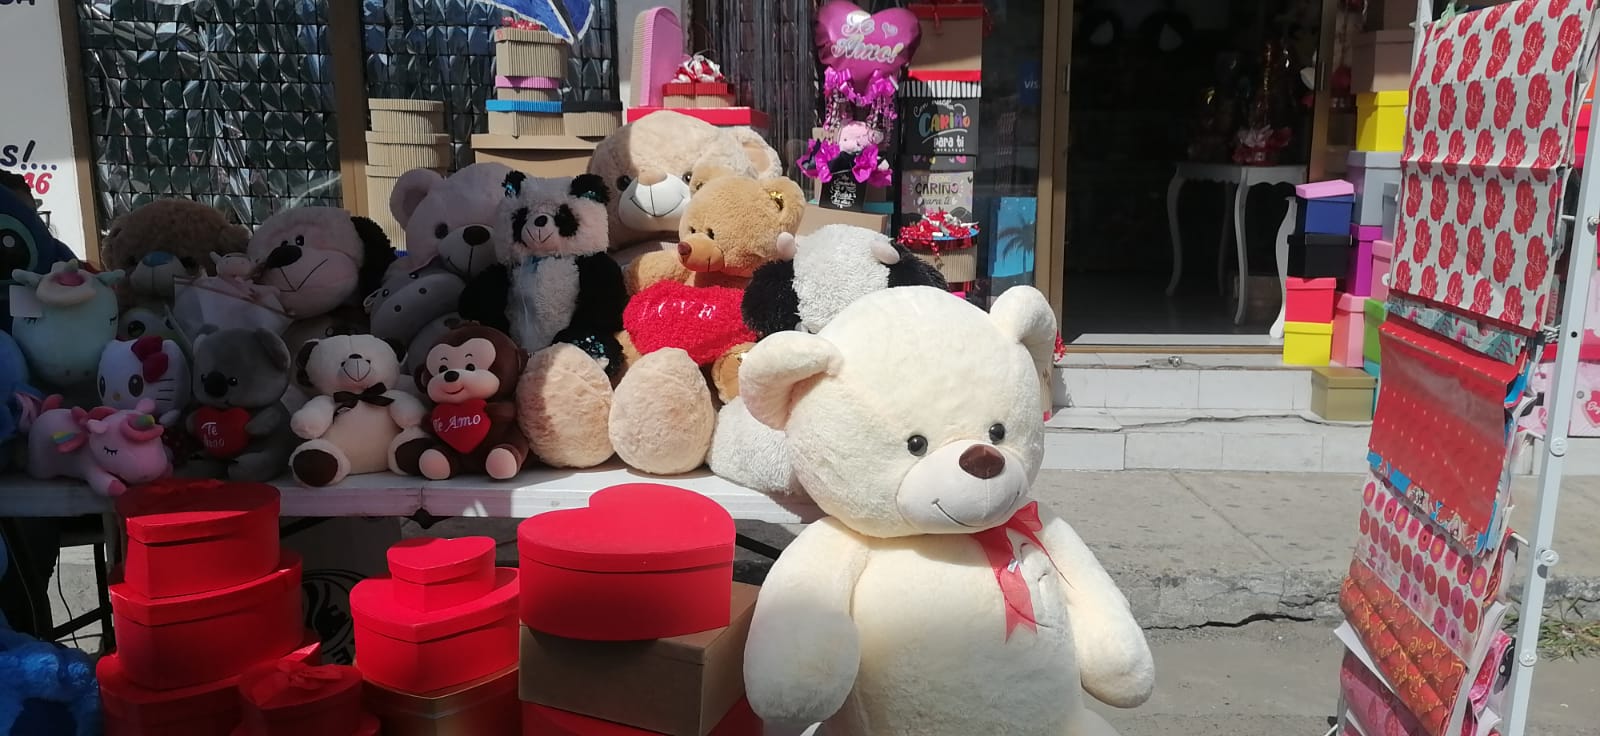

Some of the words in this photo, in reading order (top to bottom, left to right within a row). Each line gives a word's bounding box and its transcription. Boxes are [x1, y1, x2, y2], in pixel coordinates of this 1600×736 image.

[841, 10, 875, 36] Te
[1024, 80, 1040, 88] VIS
[444, 414, 481, 433] Amo
